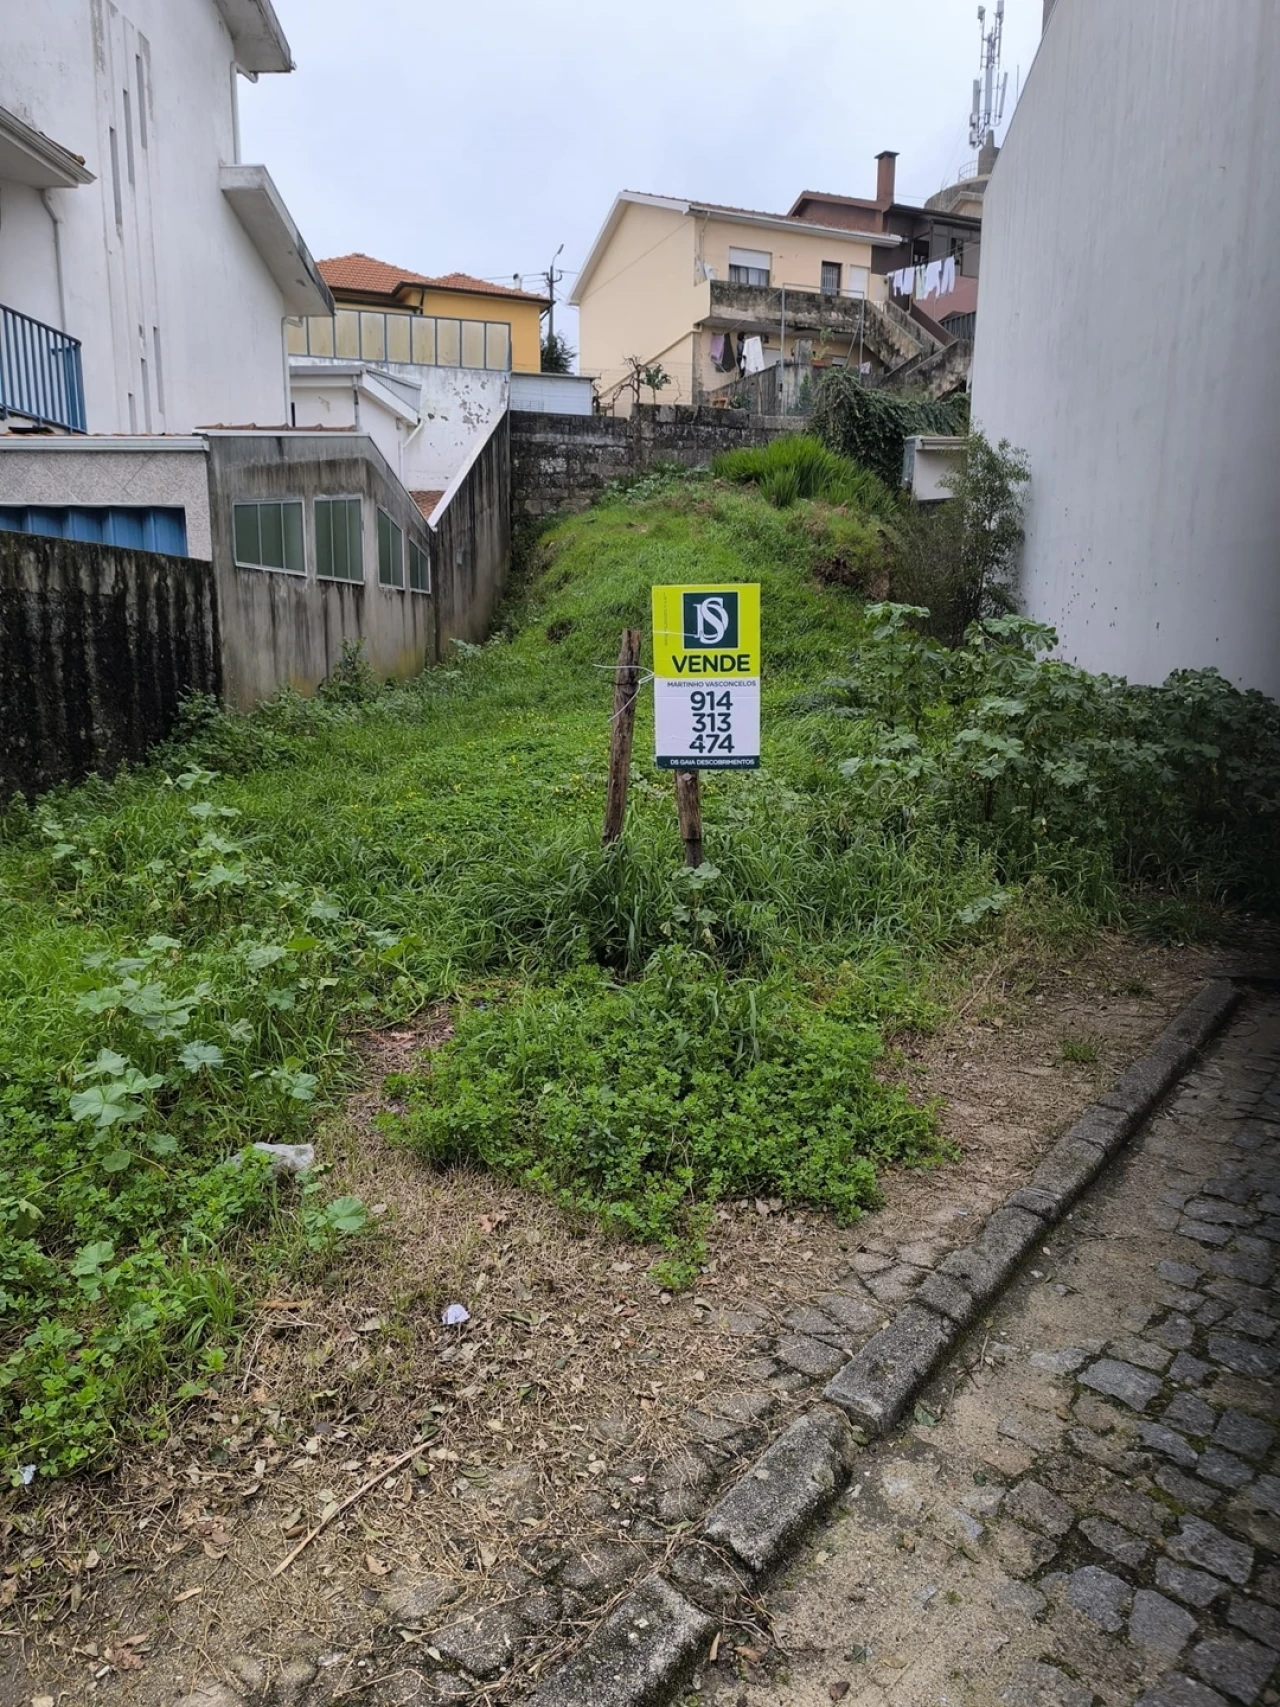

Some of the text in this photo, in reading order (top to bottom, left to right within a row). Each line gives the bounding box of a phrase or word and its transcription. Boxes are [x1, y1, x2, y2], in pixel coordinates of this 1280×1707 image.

[672, 654, 751, 673] VENDE
[705, 680, 757, 688] VASCONCELOS
[690, 690, 733, 711] 914
[692, 712, 732, 732] 313
[689, 733, 735, 754] 474
